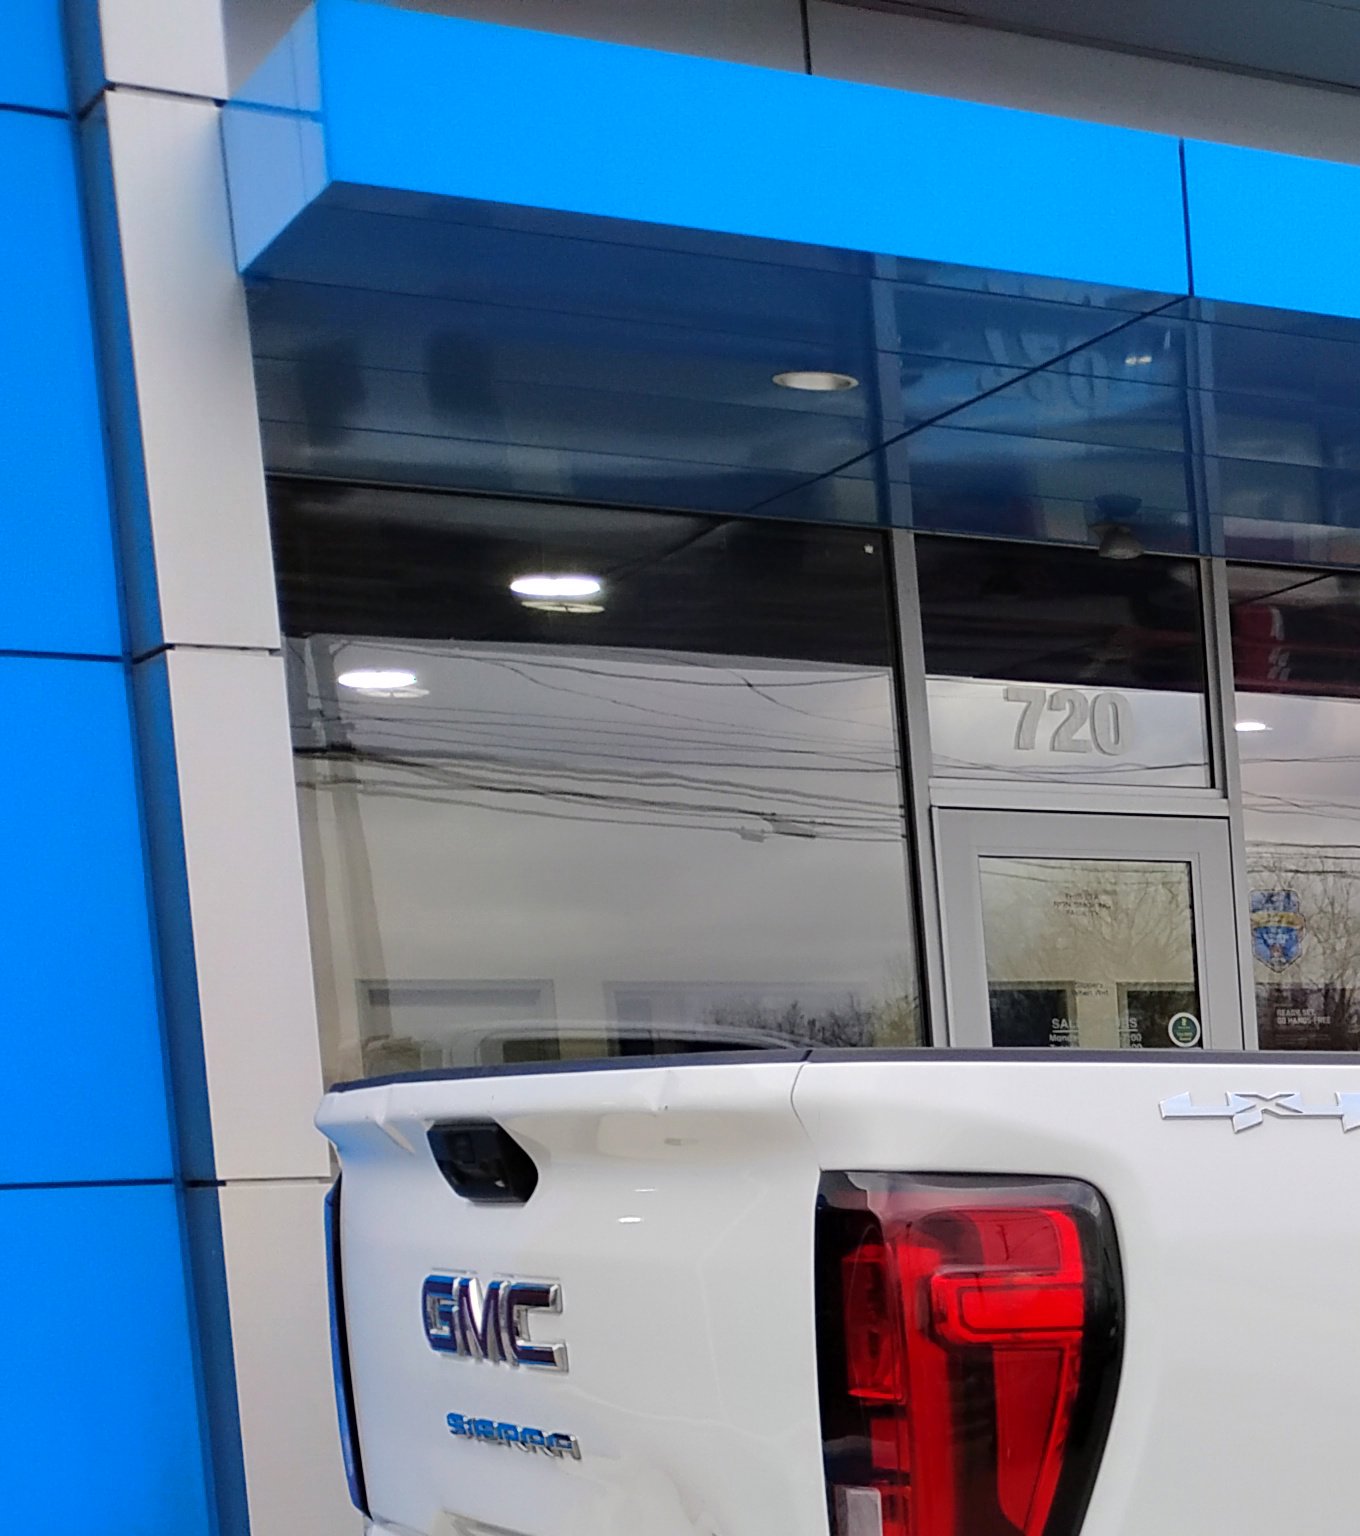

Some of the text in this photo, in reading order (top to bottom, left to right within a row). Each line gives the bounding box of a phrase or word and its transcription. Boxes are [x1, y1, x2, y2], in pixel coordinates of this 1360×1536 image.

[1002, 687, 1132, 756] 720
[422, 1270, 569, 1373] GMC
[446, 1411, 581, 1460] SIERRA
